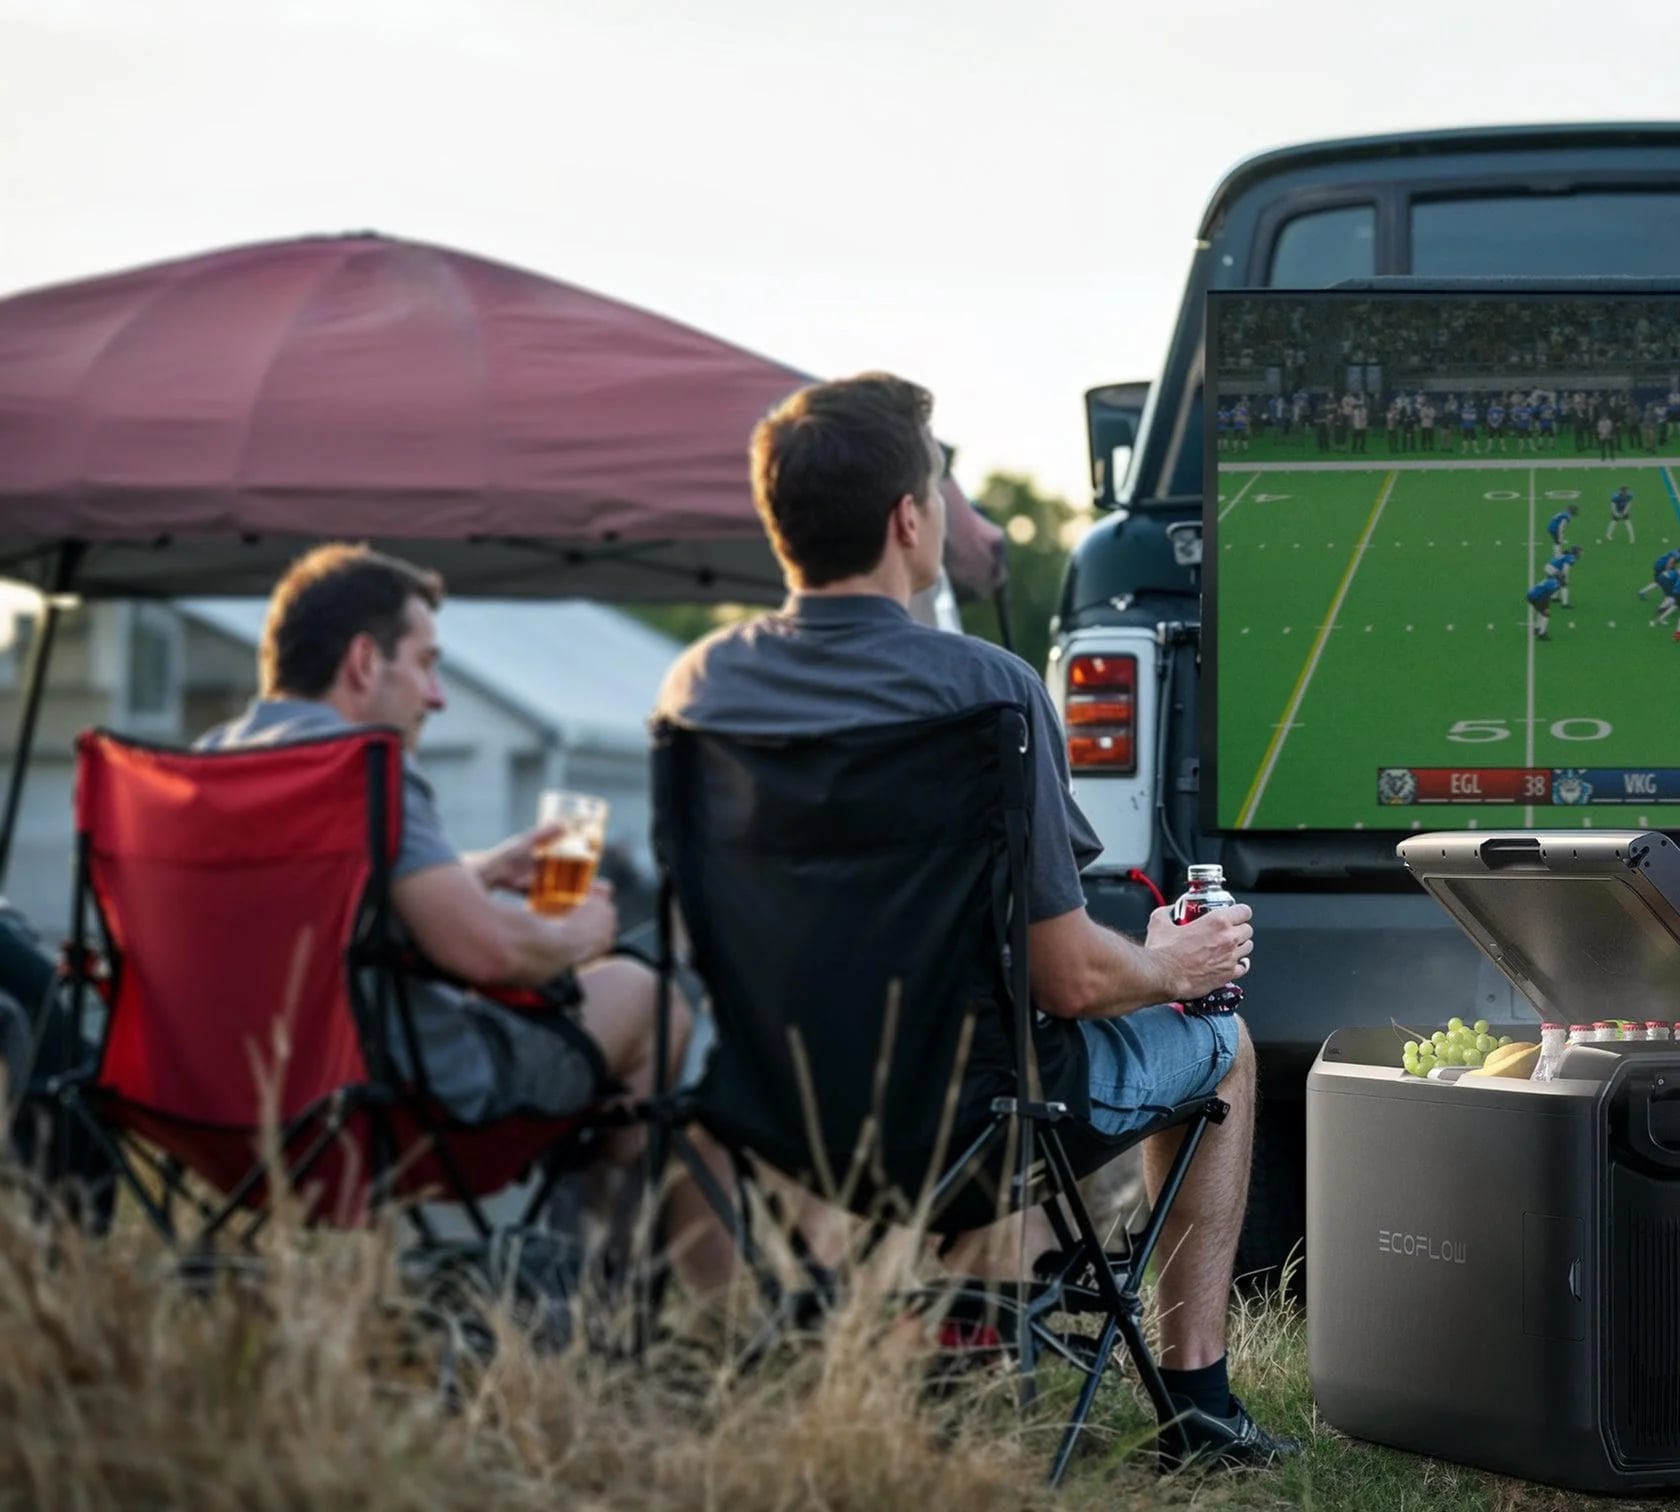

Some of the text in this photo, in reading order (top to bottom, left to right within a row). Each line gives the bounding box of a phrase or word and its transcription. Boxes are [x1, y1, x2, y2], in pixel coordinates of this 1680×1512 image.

[1451, 773, 1482, 794] EGL
[1523, 776, 1546, 796] 38
[1624, 773, 1657, 794] VKG
[1379, 1229, 1467, 1264] ECOFLOW
